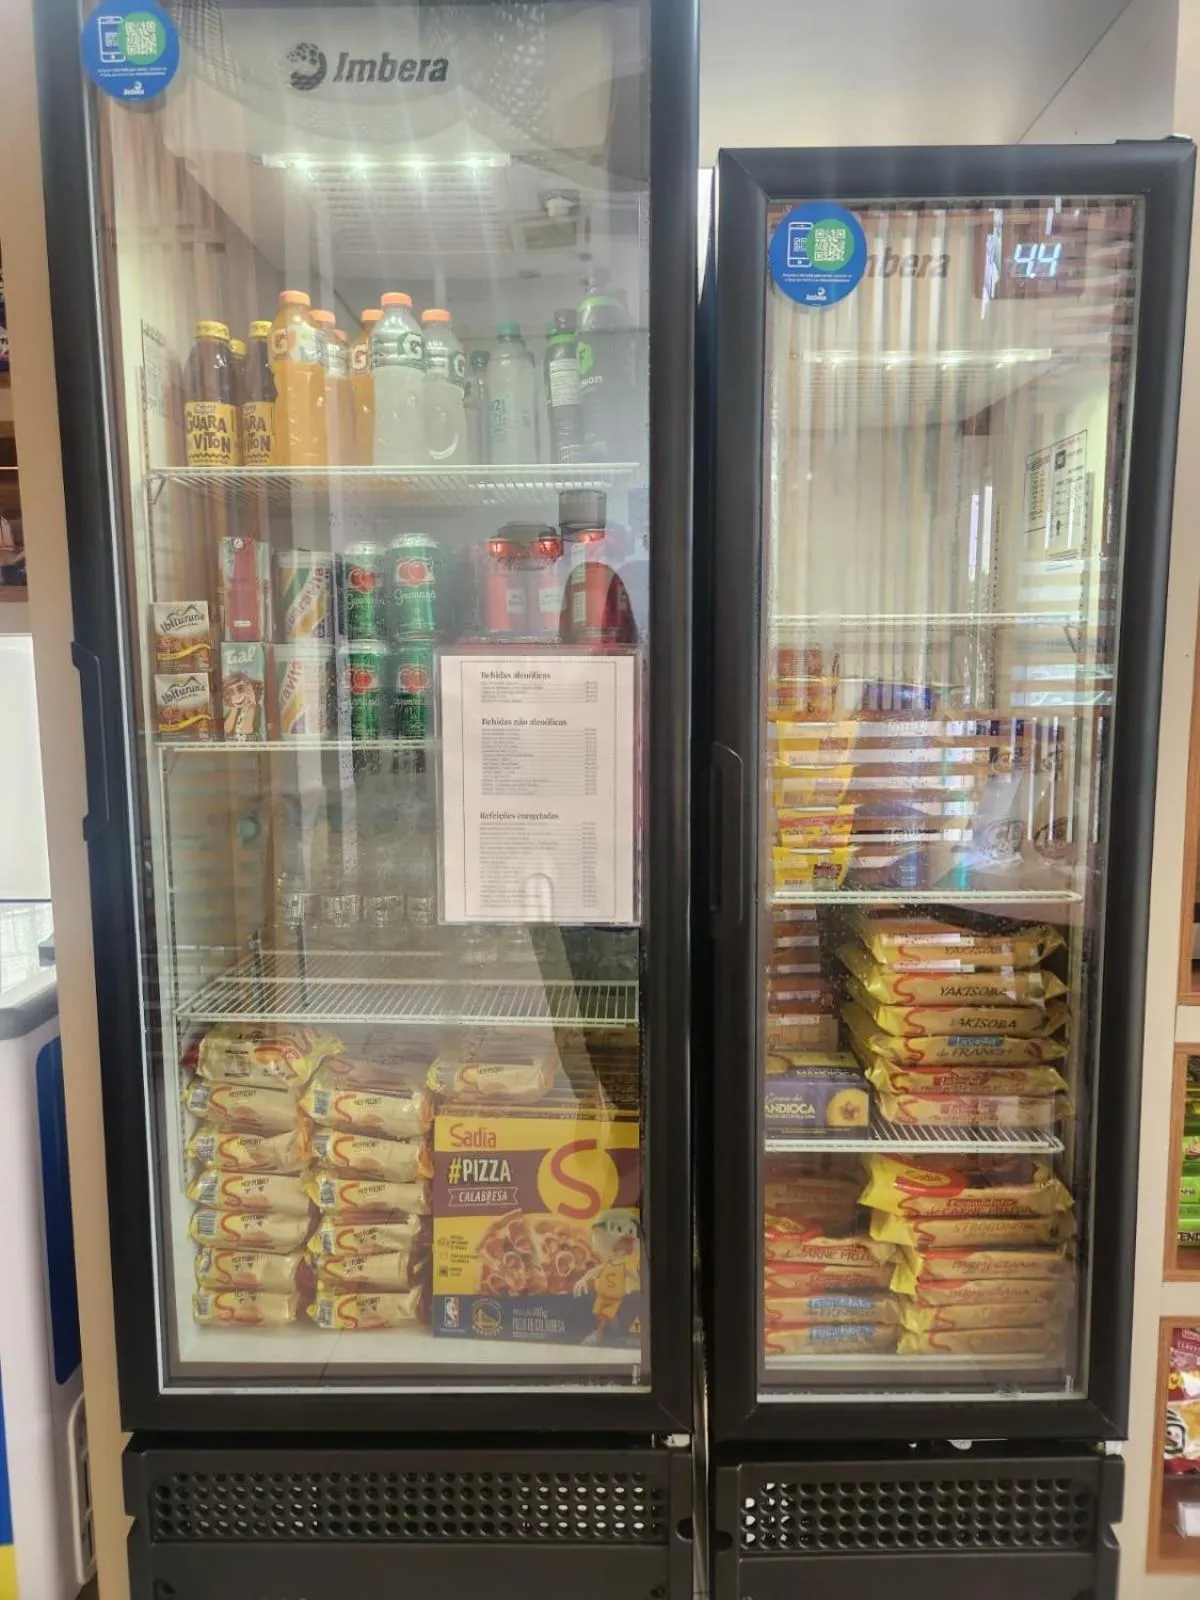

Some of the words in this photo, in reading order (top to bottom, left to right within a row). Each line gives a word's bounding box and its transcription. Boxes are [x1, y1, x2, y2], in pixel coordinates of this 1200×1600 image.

[332, 51, 449, 82] Imbera
[939, 985, 1008, 997] YAKISOBA
[952, 1019, 1017, 1030] AKISOBA
[764, 1103, 816, 1115] ANDIOCA
[449, 1122, 497, 1149] Sadia
[447, 1158, 512, 1185] #PIZZA
[458, 1189, 508, 1204] CALABRESA
